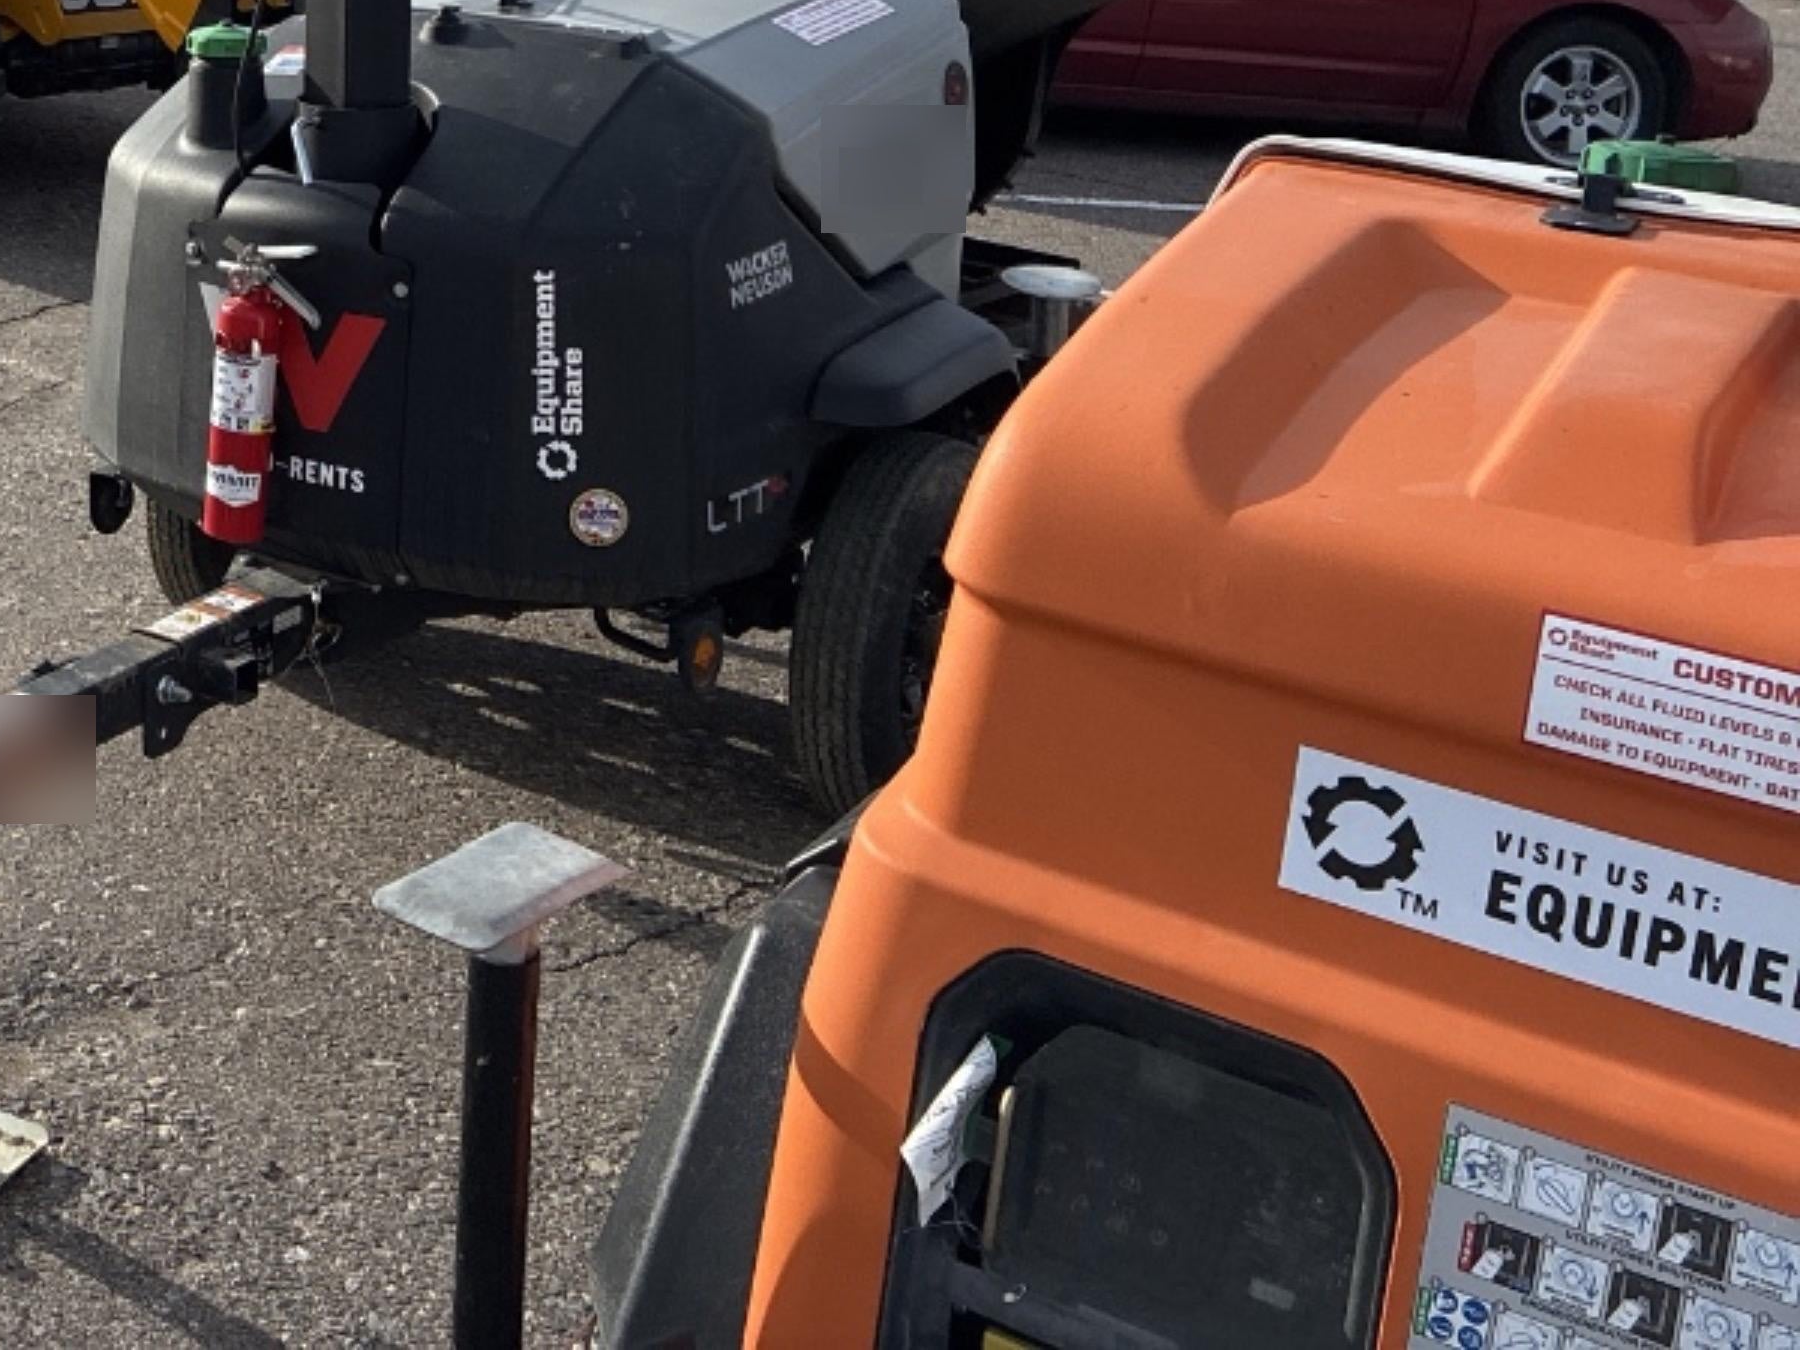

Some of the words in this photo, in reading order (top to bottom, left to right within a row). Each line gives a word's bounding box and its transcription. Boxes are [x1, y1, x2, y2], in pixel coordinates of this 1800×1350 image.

[531, 269, 560, 435] Equipment
[560, 347, 583, 436] Share
[1554, 674, 1612, 700] CHECK
[1616, 689, 1646, 709] ALL
[1653, 698, 1705, 724] FLUID
[1709, 714, 1774, 742] LEVELS
[1580, 707, 1683, 745] INSURANCE
[1698, 737, 1740, 759] FLAT
[1537, 721, 1611, 753] DAMAGE
[1617, 742, 1638, 760] TO
[1643, 751, 1751, 790] EQUIPMENT
[1397, 888, 1439, 919] TM
[1496, 830, 1588, 876] VISIT
[1607, 862, 1649, 895] US
[1667, 881, 1722, 913] AT:
[1484, 869, 1800, 1010] EQUIPME
